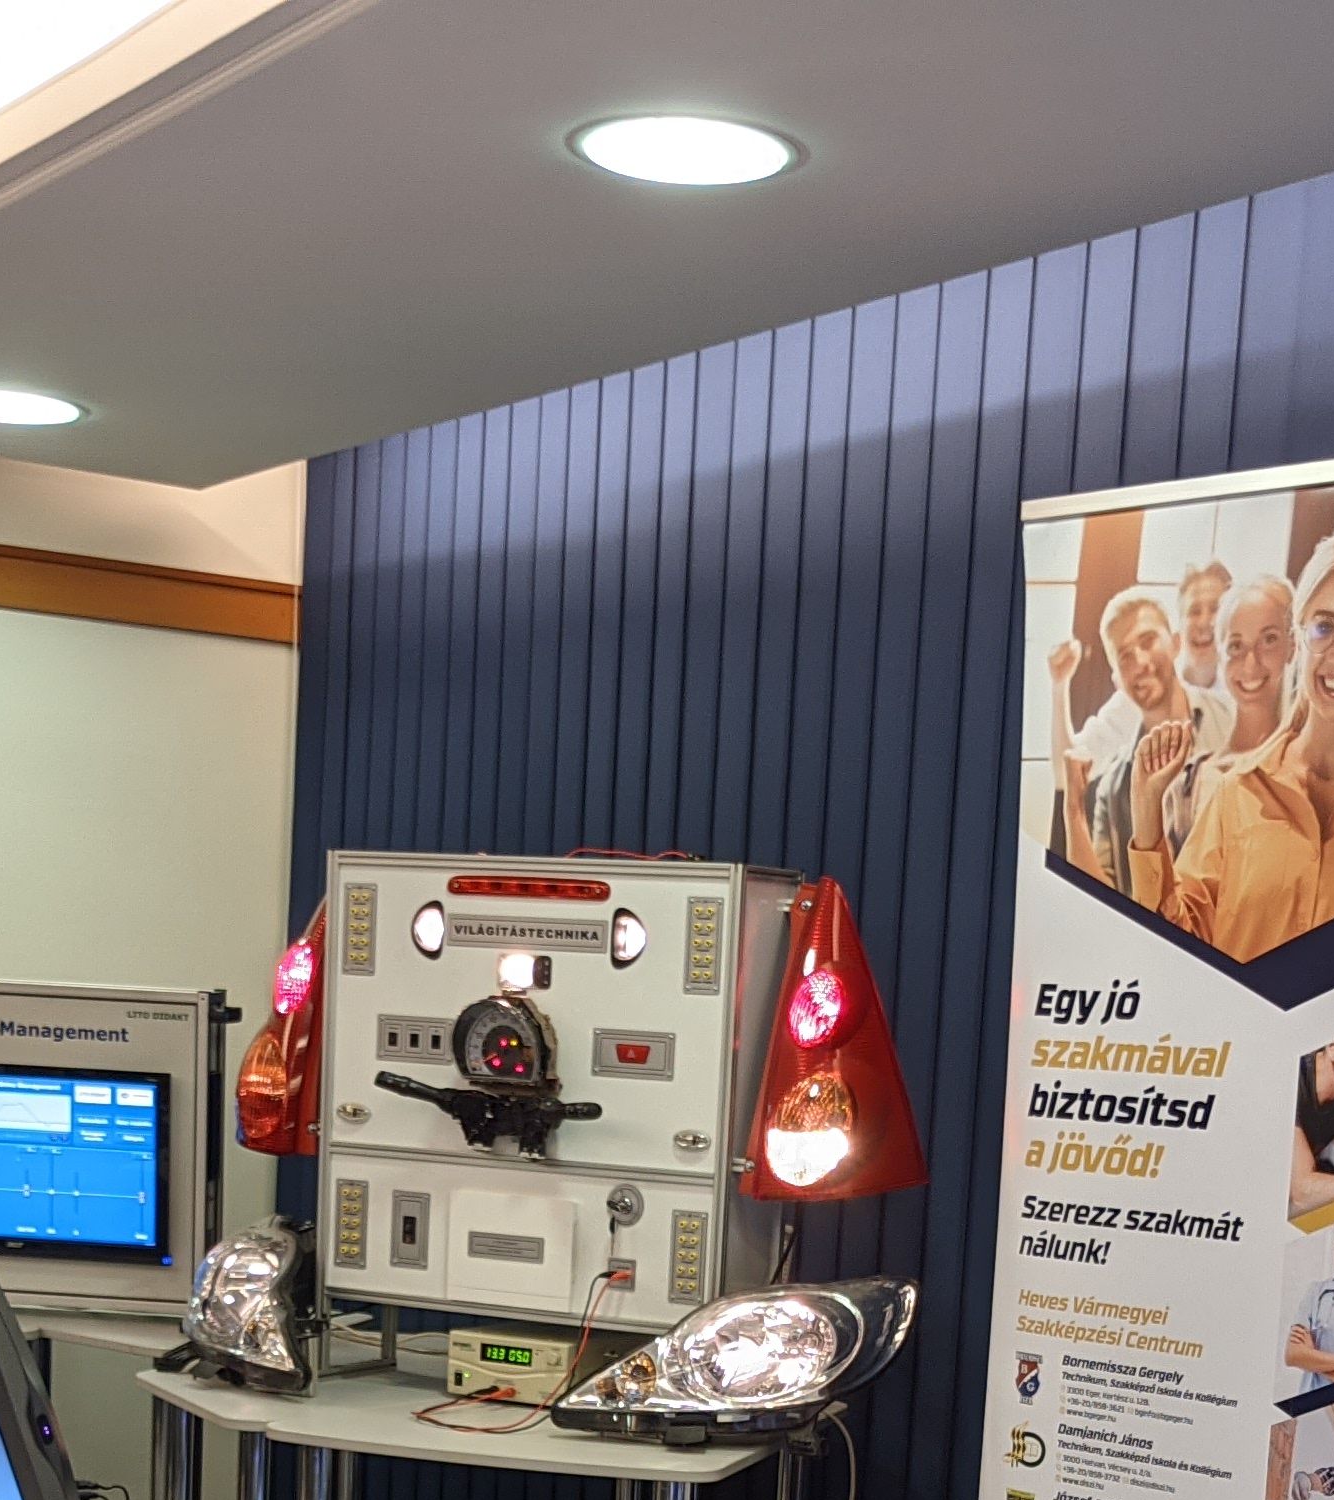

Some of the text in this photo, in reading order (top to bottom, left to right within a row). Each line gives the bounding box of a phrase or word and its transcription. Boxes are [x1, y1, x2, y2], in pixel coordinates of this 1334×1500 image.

[454, 924, 599, 941] VILÁGÍTÁSTECHNIKA
[1034, 980, 1141, 1027] Egy jó
[0, 1021, 129, 1043] Management
[1031, 1034, 1231, 1078] szakmával
[1027, 1081, 1216, 1130] biztosítsd
[1025, 1130, 1165, 1178] a jövőd!
[1021, 1195, 1244, 1243] Szerezz szakmát
[1019, 1231, 1111, 1266] nálunk!
[1018, 1289, 1169, 1327] Heves Vármegyei
[1015, 1315, 1203, 1358] Szakképzési Centrum
[1062, 1355, 1136, 1377] Bornemissza
[1139, 1366, 1184, 1384] Gergely
[1057, 1423, 1154, 1450] Damjanich János
